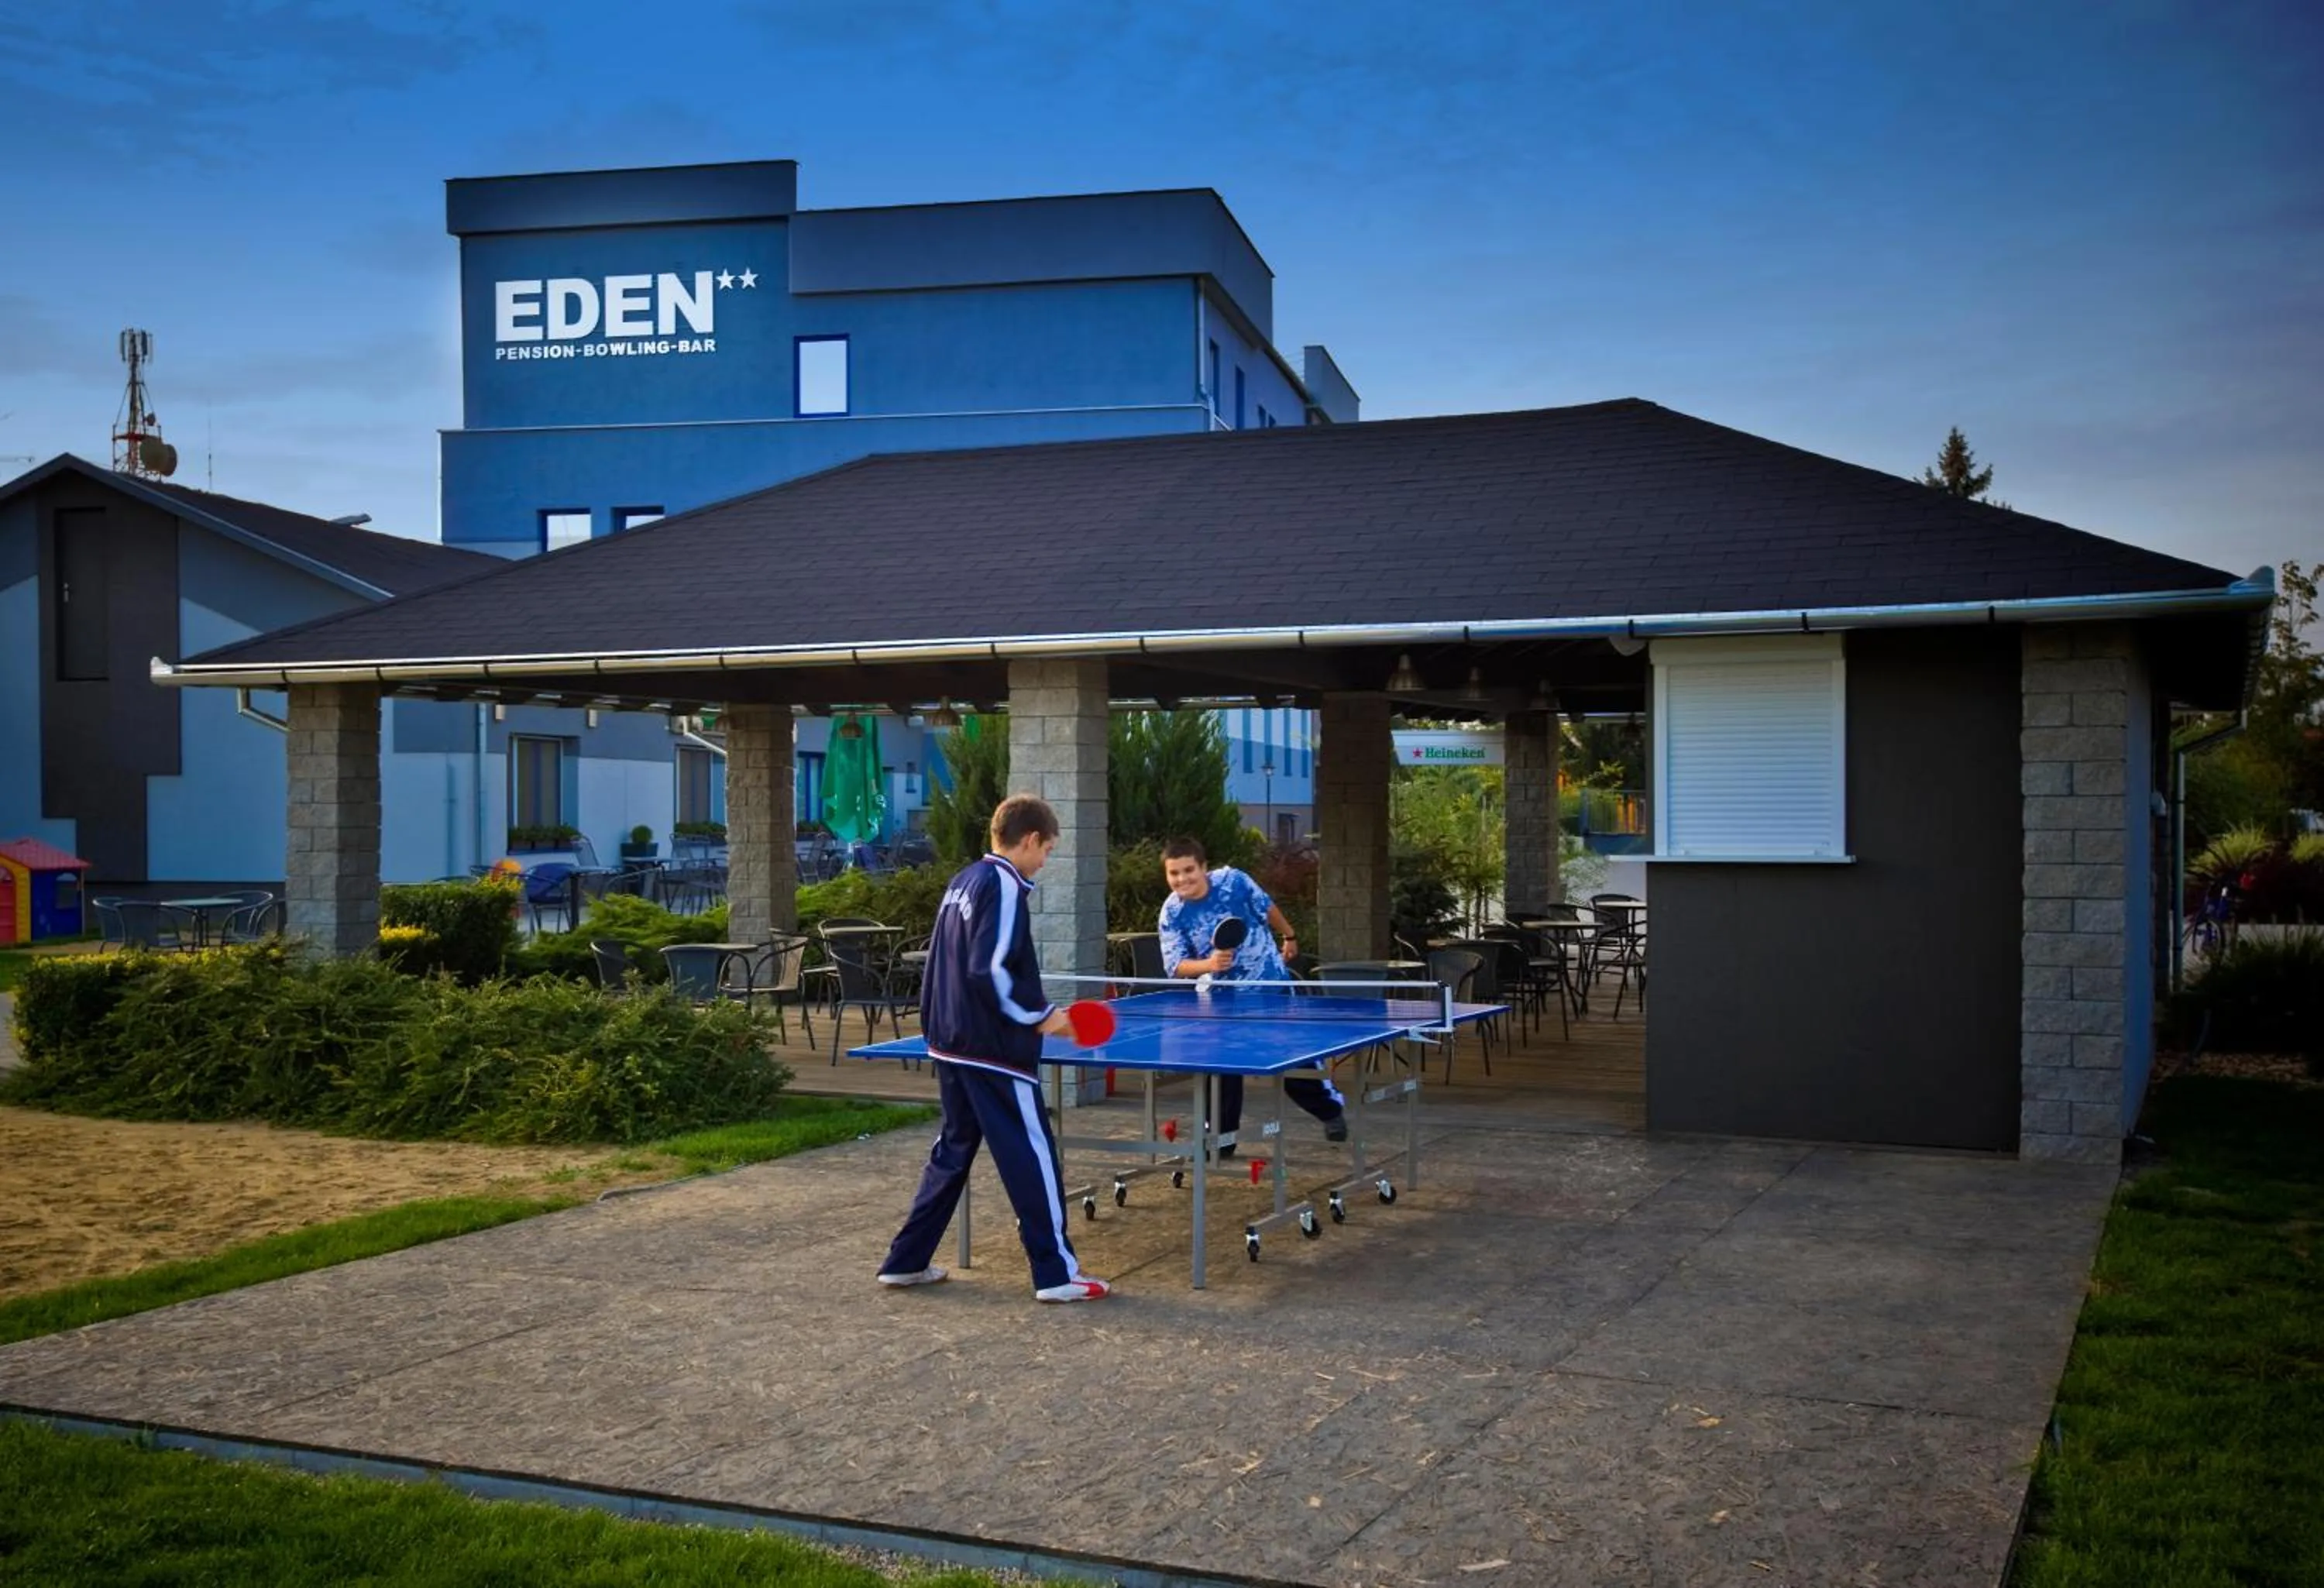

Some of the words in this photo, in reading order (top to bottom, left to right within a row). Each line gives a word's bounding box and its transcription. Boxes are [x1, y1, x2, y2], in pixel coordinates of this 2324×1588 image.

[495, 271, 713, 342] EDEN
[495, 339, 716, 360] PENSION-BOWLING-BAR
[1425, 747, 1485, 759] Heineken
